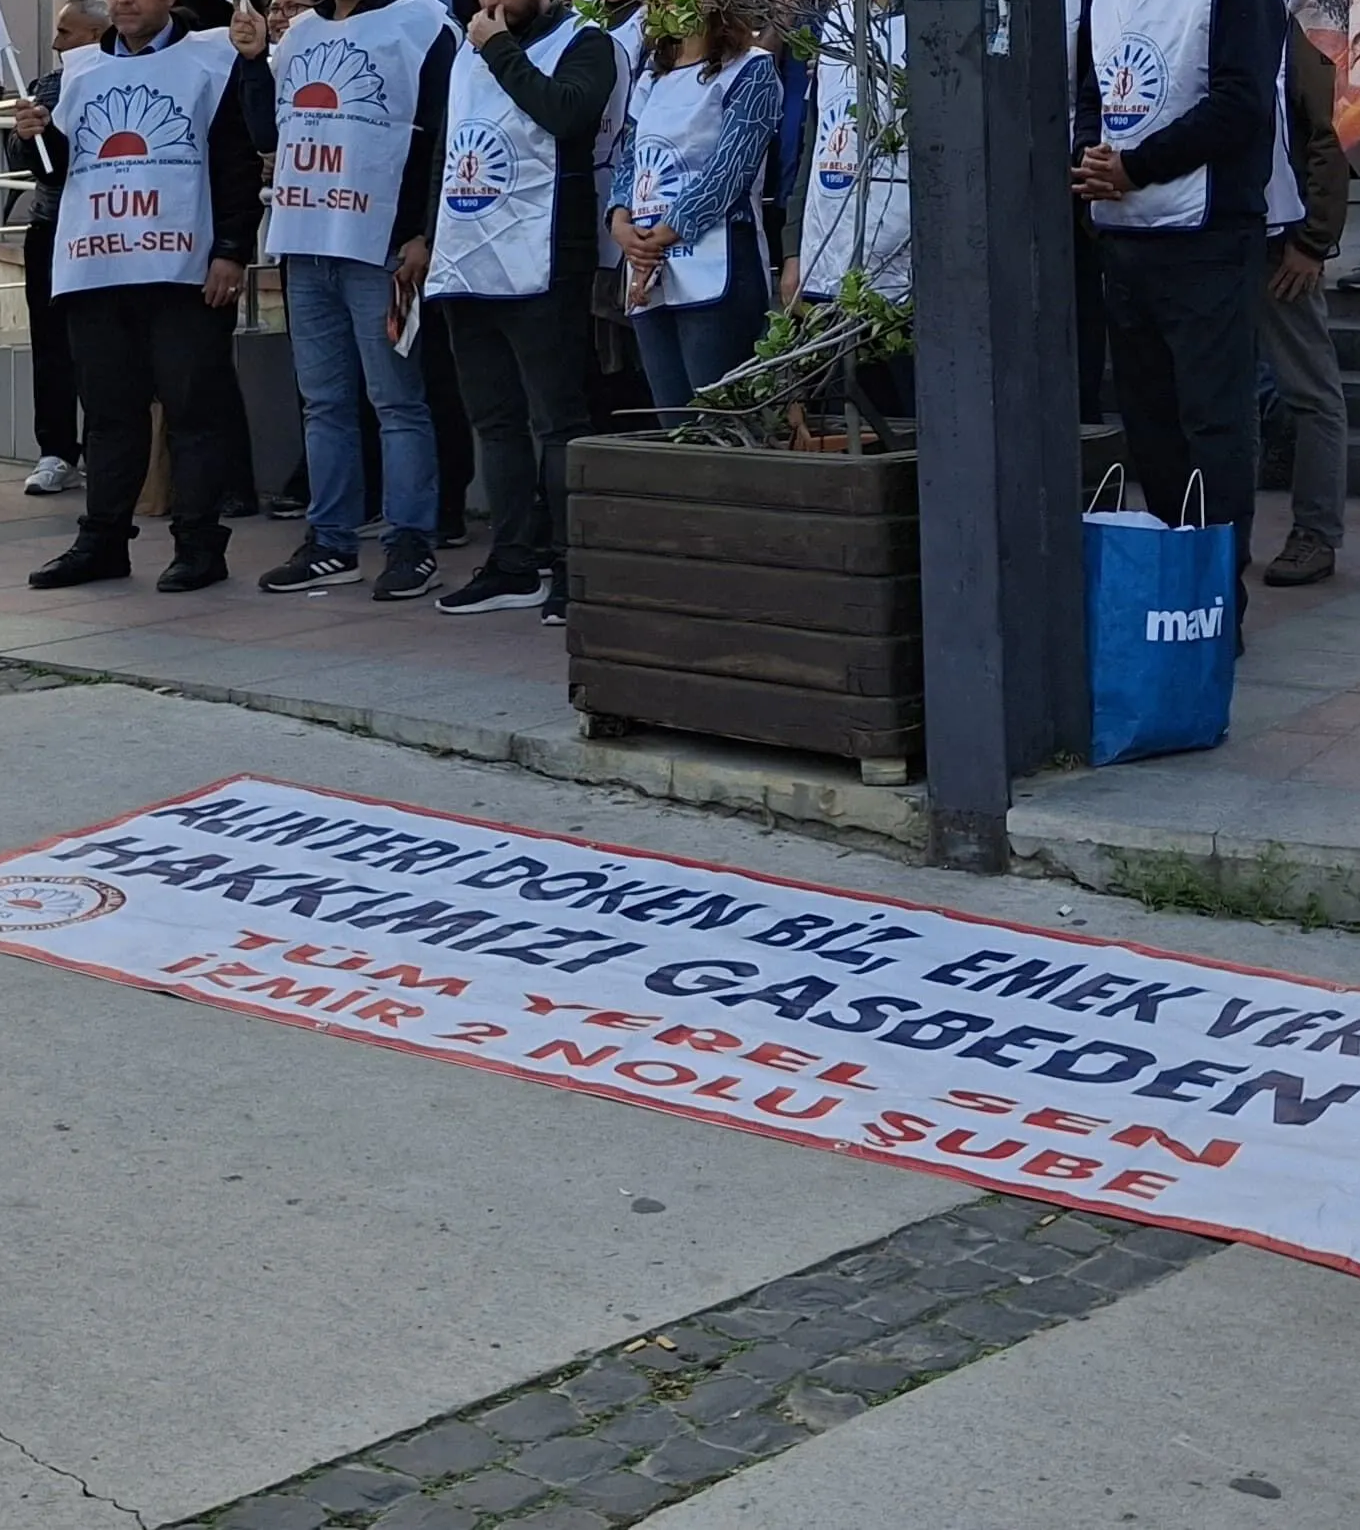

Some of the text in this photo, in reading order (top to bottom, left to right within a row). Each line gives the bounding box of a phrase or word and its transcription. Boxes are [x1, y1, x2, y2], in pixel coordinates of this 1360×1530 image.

[68, 230, 193, 260] YEREL-SEN
[89, 184, 159, 220] TÜM
[1146, 596, 1223, 642] mavi
[50, 836, 649, 973] HAKKIMIZI
[149, 797, 510, 876] ALINTERİ
[456, 855, 769, 931] DÖKEN
[744, 912, 924, 974] BİZ,
[922, 950, 1205, 1024] EMEK
[159, 952, 1179, 1201] İZMİR 2 NOLU ŞUBE
[229, 928, 1243, 1168] TÜM YEREL SEN
